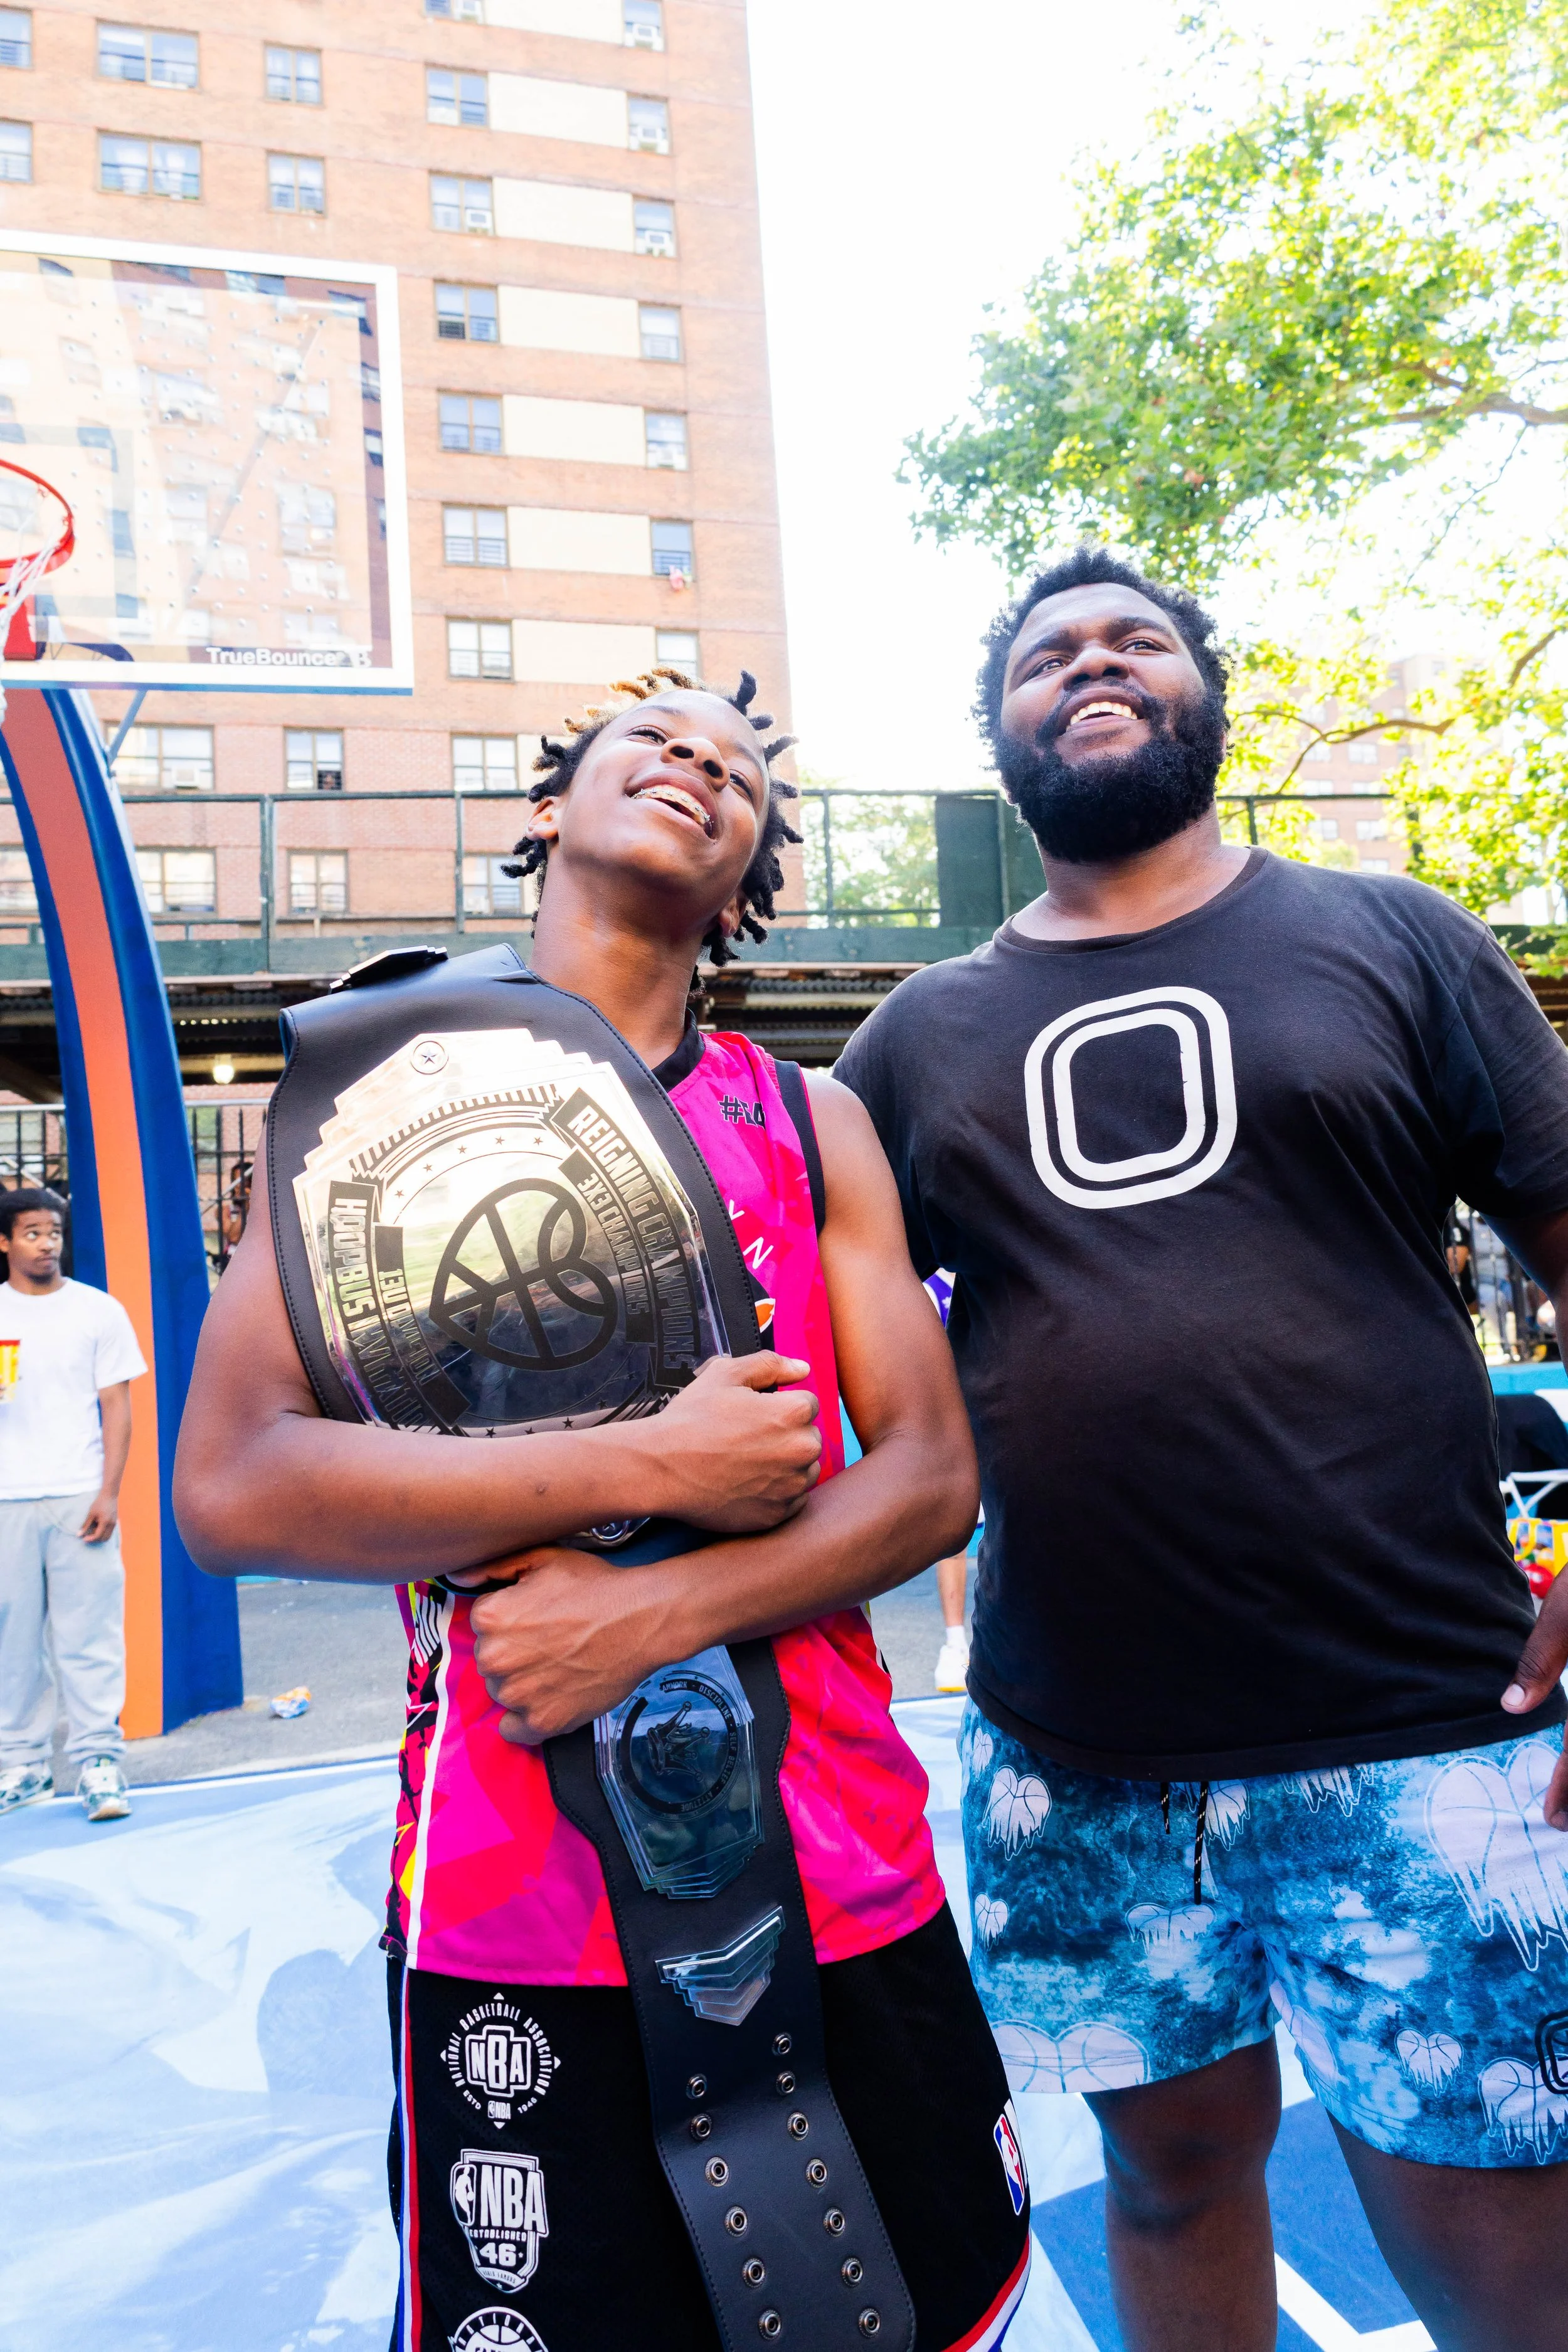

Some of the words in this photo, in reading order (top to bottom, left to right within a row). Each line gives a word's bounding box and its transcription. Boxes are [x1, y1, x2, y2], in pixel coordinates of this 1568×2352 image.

[206, 647, 335, 666] TrueBounce
[567, 1104, 660, 1218] REIGNING
[637, 1212, 696, 1370] CHAMPIONS
[576, 1172, 613, 1212] 3X3
[597, 1205, 650, 1316] CHAMPIONS
[329, 1197, 376, 1318] HOOPBUS
[378, 1268, 409, 1305] 13U
[699, 1683, 733, 1720] DISCIPLINE
[729, 1732, 737, 1752] SELF
[721, 1756, 736, 1784] BELIEF
[447, 2032, 466, 2087] NATIONAL
[459, 2003, 521, 2031] BASKETBALL
[523, 2017, 553, 2095] ASSOCIATION
[471, 2035, 525, 2089] NBA
[463, 2090, 482, 2110] ESTD
[494, 2102, 511, 2119] NBA
[517, 2097, 538, 2114] 1946
[480, 2164, 545, 2233] NBA
[469, 2229, 527, 2242] ESTABLISHED
[479, 2242, 516, 2267] 46
